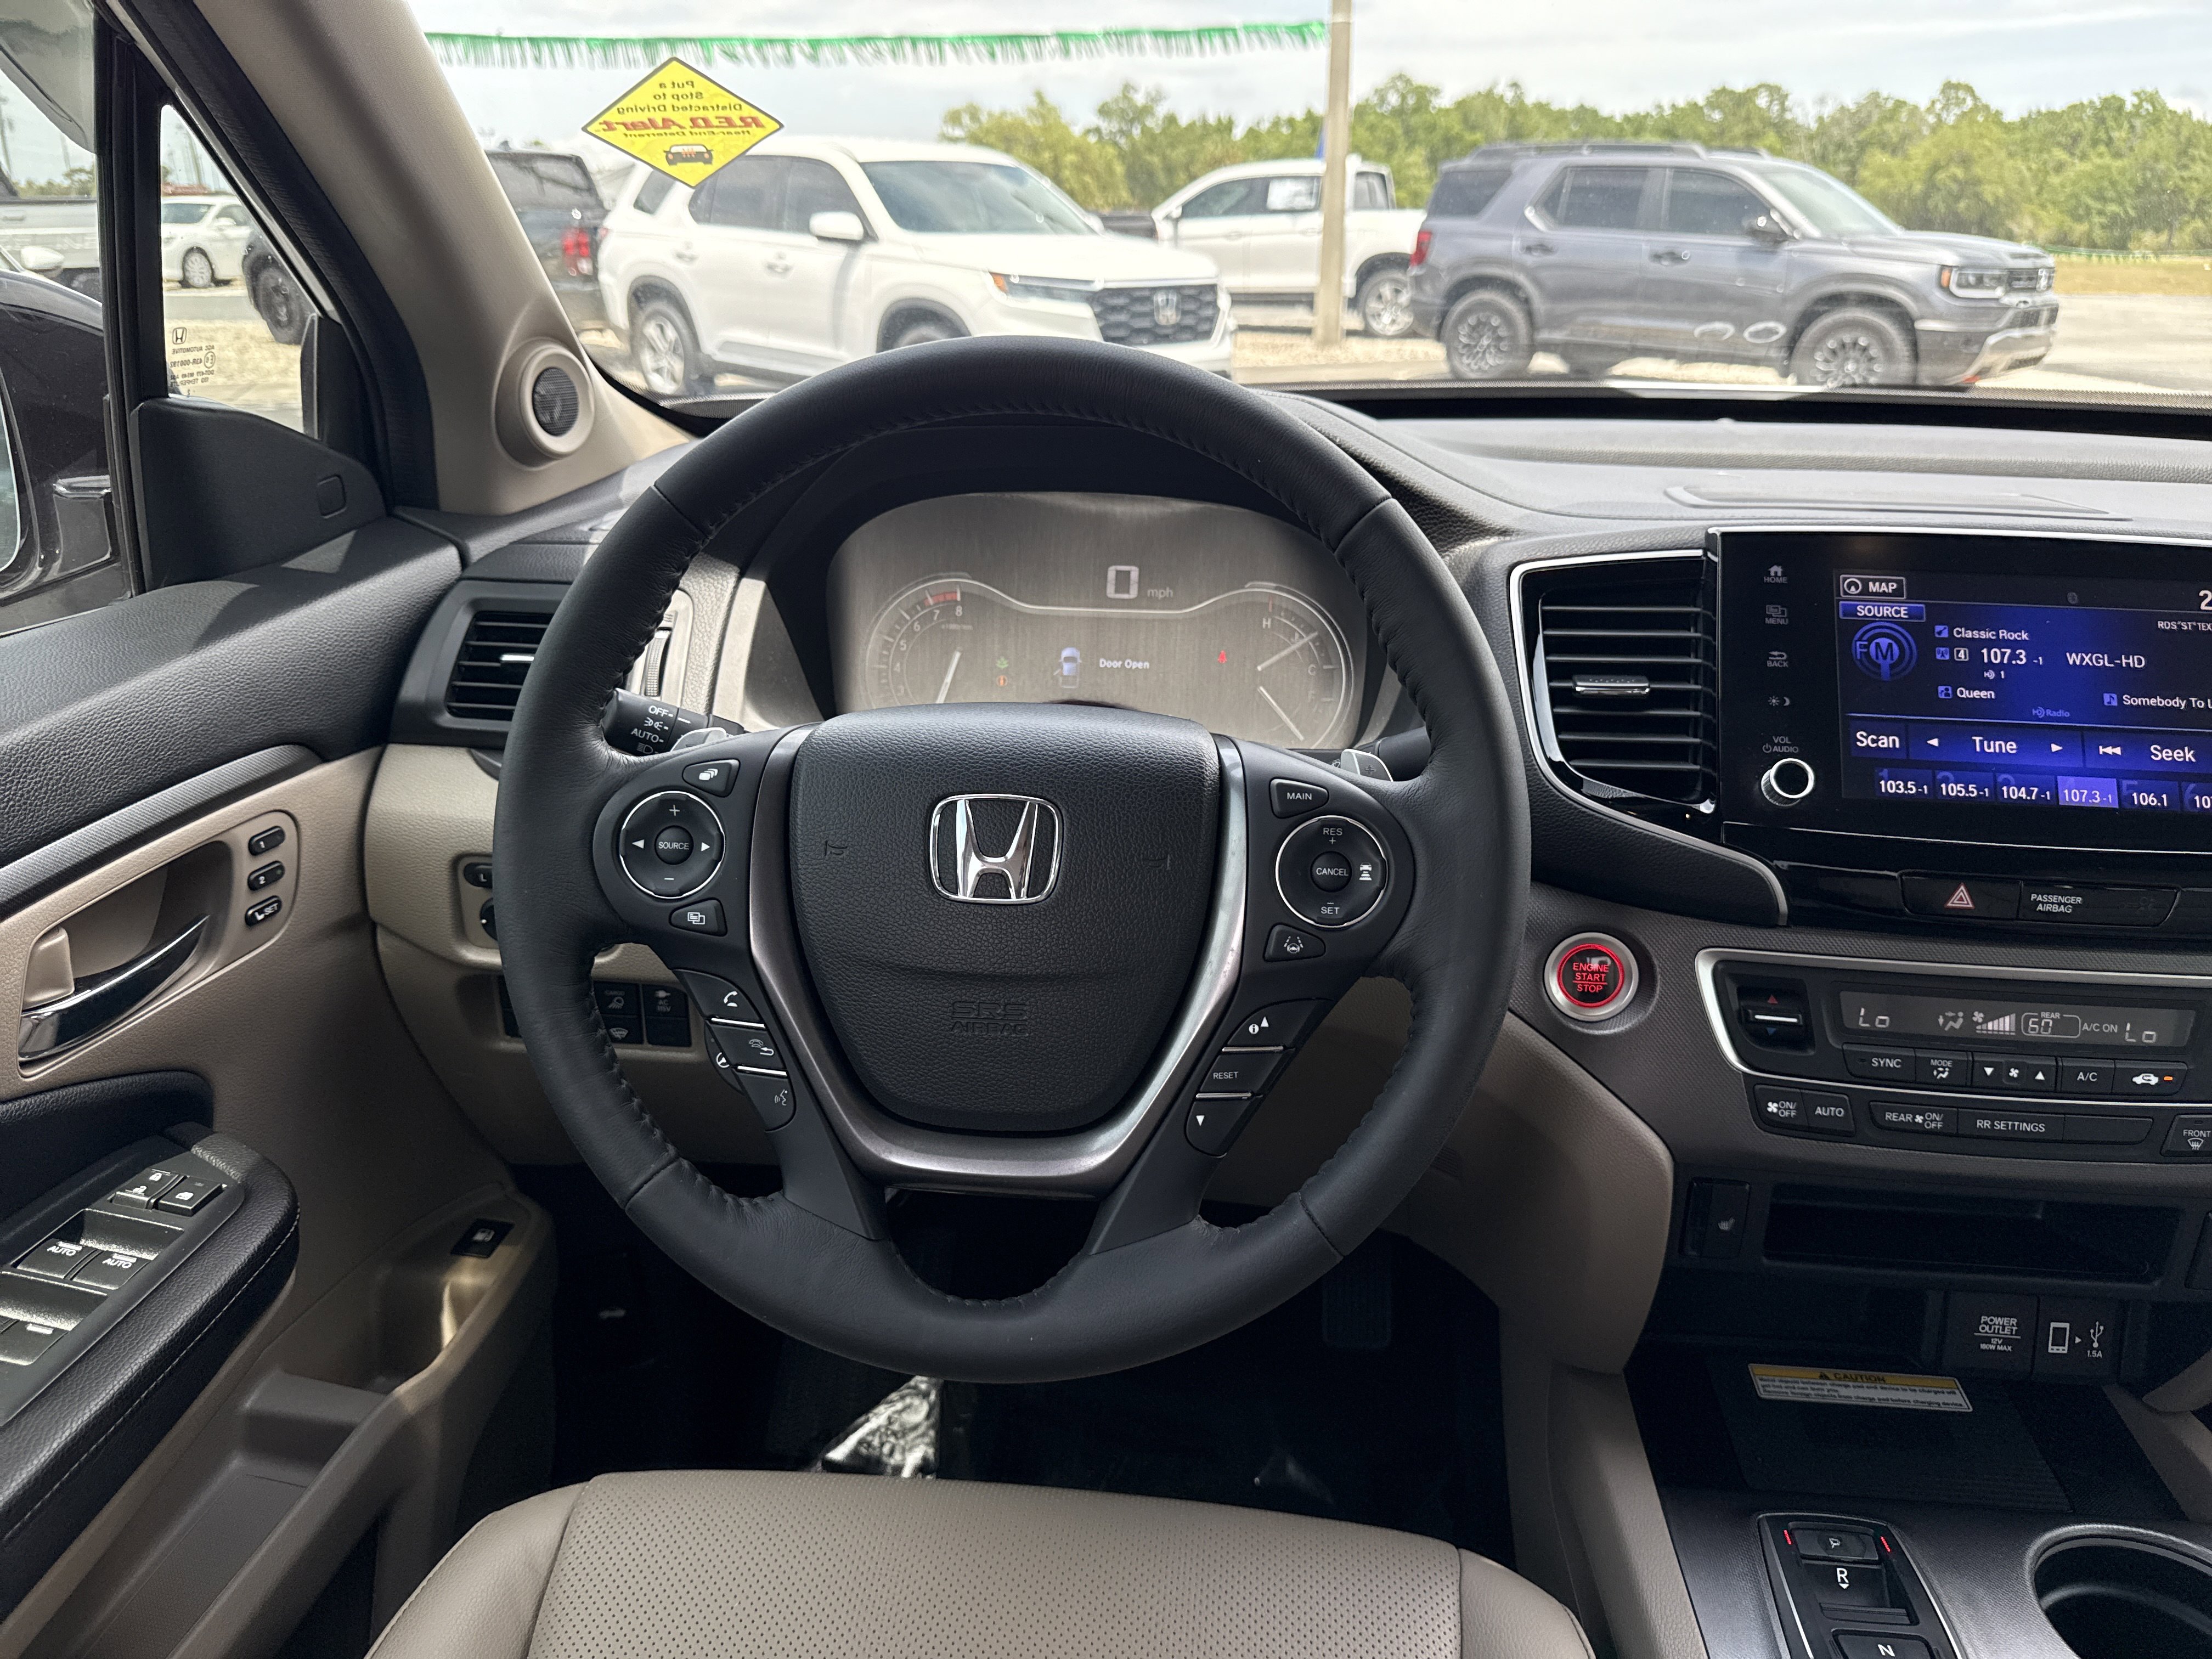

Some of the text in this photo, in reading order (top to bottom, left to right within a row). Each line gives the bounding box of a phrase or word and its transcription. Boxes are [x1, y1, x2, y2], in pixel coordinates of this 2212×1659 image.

[1107, 565, 1173, 600] 0 mph
[1869, 582, 1897, 594] MAP
[934, 610, 940, 620] 7
[955, 606, 962, 617] 8
[1857, 605, 1909, 618] SOURCE
[913, 623, 921, 631] 6
[1263, 618, 1271, 629] H
[1953, 628, 2030, 641] Classic Rock
[1099, 658, 1150, 669] Door Open
[1958, 650, 1965, 659] 4
[1981, 648, 2027, 664] 107.3
[2066, 652, 2145, 669] WXGL-HD
[1956, 687, 1995, 700] Queen
[2123, 694, 2186, 710] Somebody
[2190, 697, 2205, 708] To
[2046, 708, 2070, 718] Radio
[1773, 736, 1791, 744] VOL
[1856, 731, 2196, 762] Scan Tune Seek
[2132, 792, 2168, 806] 106.1
[1323, 828, 1342, 836] RES
[658, 842, 690, 850] SOURCE
[1316, 868, 1348, 876] CANCEL
[2031, 894, 2083, 905] PASSENGER
[2036, 904, 2072, 913] AIRBAG
[1573, 962, 1609, 972] ENGINE
[1575, 973, 1606, 981] START
[1577, 984, 1603, 993] STOP
[2082, 1023, 2101, 1032] A/C
[2102, 1023, 2118, 1033] ON
[1871, 1058, 1901, 1068] SYNC
[2077, 1072, 2098, 1082] A/C
[1778, 1109, 1797, 1118] OFF
[1815, 1106, 1844, 1117] AUTO
[1885, 1112, 1913, 1122] REAR
[1924, 1121, 1943, 1130] OFF
[1976, 1119, 2045, 1132] RR SETTINGS
[47, 1246, 76, 1256] AUTO
[102, 1258, 132, 1268] AUTO
[1980, 1316, 2017, 1327] POWER
[1979, 1324, 2018, 1335] OUTLET
[2087, 1350, 2103, 1358] 1.5A
[1833, 1373, 1886, 1384] CAUTION
[1829, 1538, 1841, 1549] P
[1836, 1567, 1849, 1583] R
[1877, 1644, 1895, 1657] N
